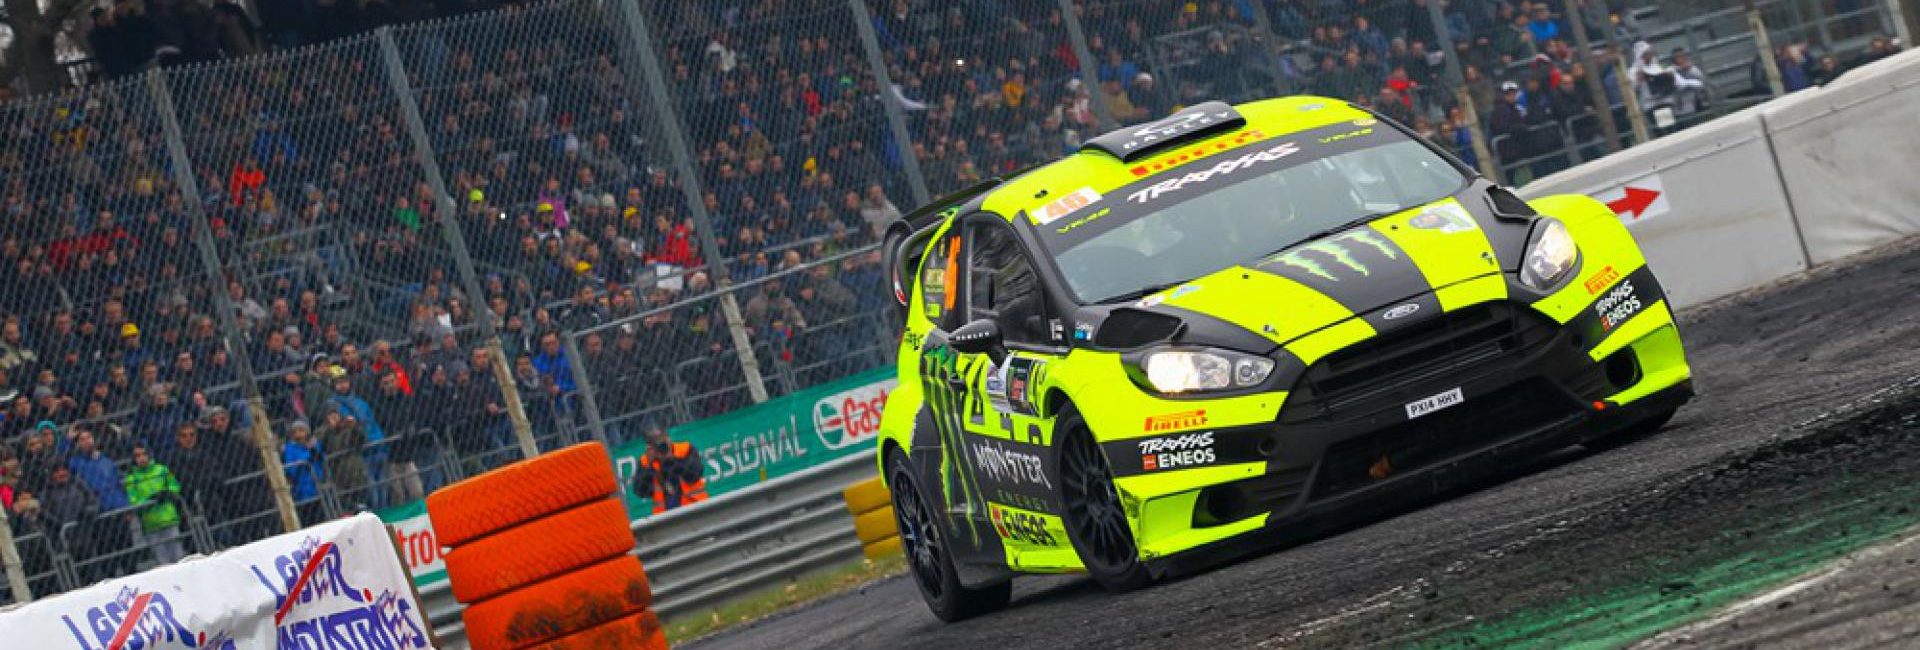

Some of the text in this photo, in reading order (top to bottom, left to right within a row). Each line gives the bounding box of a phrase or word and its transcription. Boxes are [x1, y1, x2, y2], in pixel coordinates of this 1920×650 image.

[1127, 142, 1300, 203] TRAXXAS
[1584, 265, 1620, 295] PIRELLI
[1595, 280, 1634, 317] TRAXXAS
[1607, 295, 1641, 327] ENEOS
[1144, 408, 1209, 432] PIRELLI
[1138, 431, 1215, 454] TRAXXAS
[1158, 447, 1216, 469] ENEOS
[972, 438, 1053, 491] MONSTER
[1002, 508, 1058, 546] ENEOS
